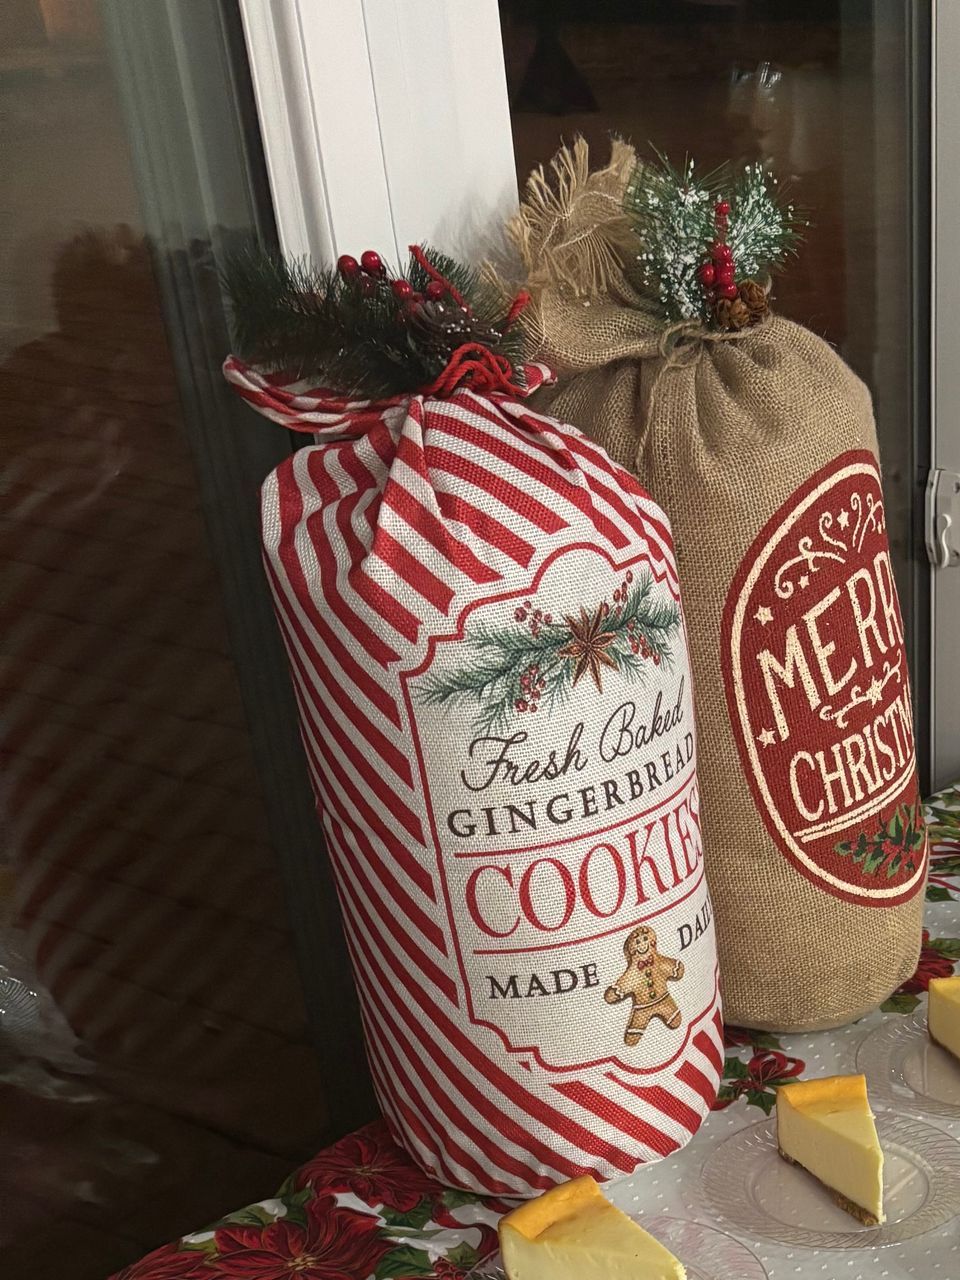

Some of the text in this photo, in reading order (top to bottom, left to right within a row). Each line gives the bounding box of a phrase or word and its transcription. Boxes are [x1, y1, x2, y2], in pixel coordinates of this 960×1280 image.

[757, 551, 904, 741] MERR
[446, 732, 694, 839] GINGERBREAD
[461, 675, 686, 792] Fresh Baked
[789, 674, 914, 824] CHRISTM
[486, 895, 712, 1000] MADE DAIL
